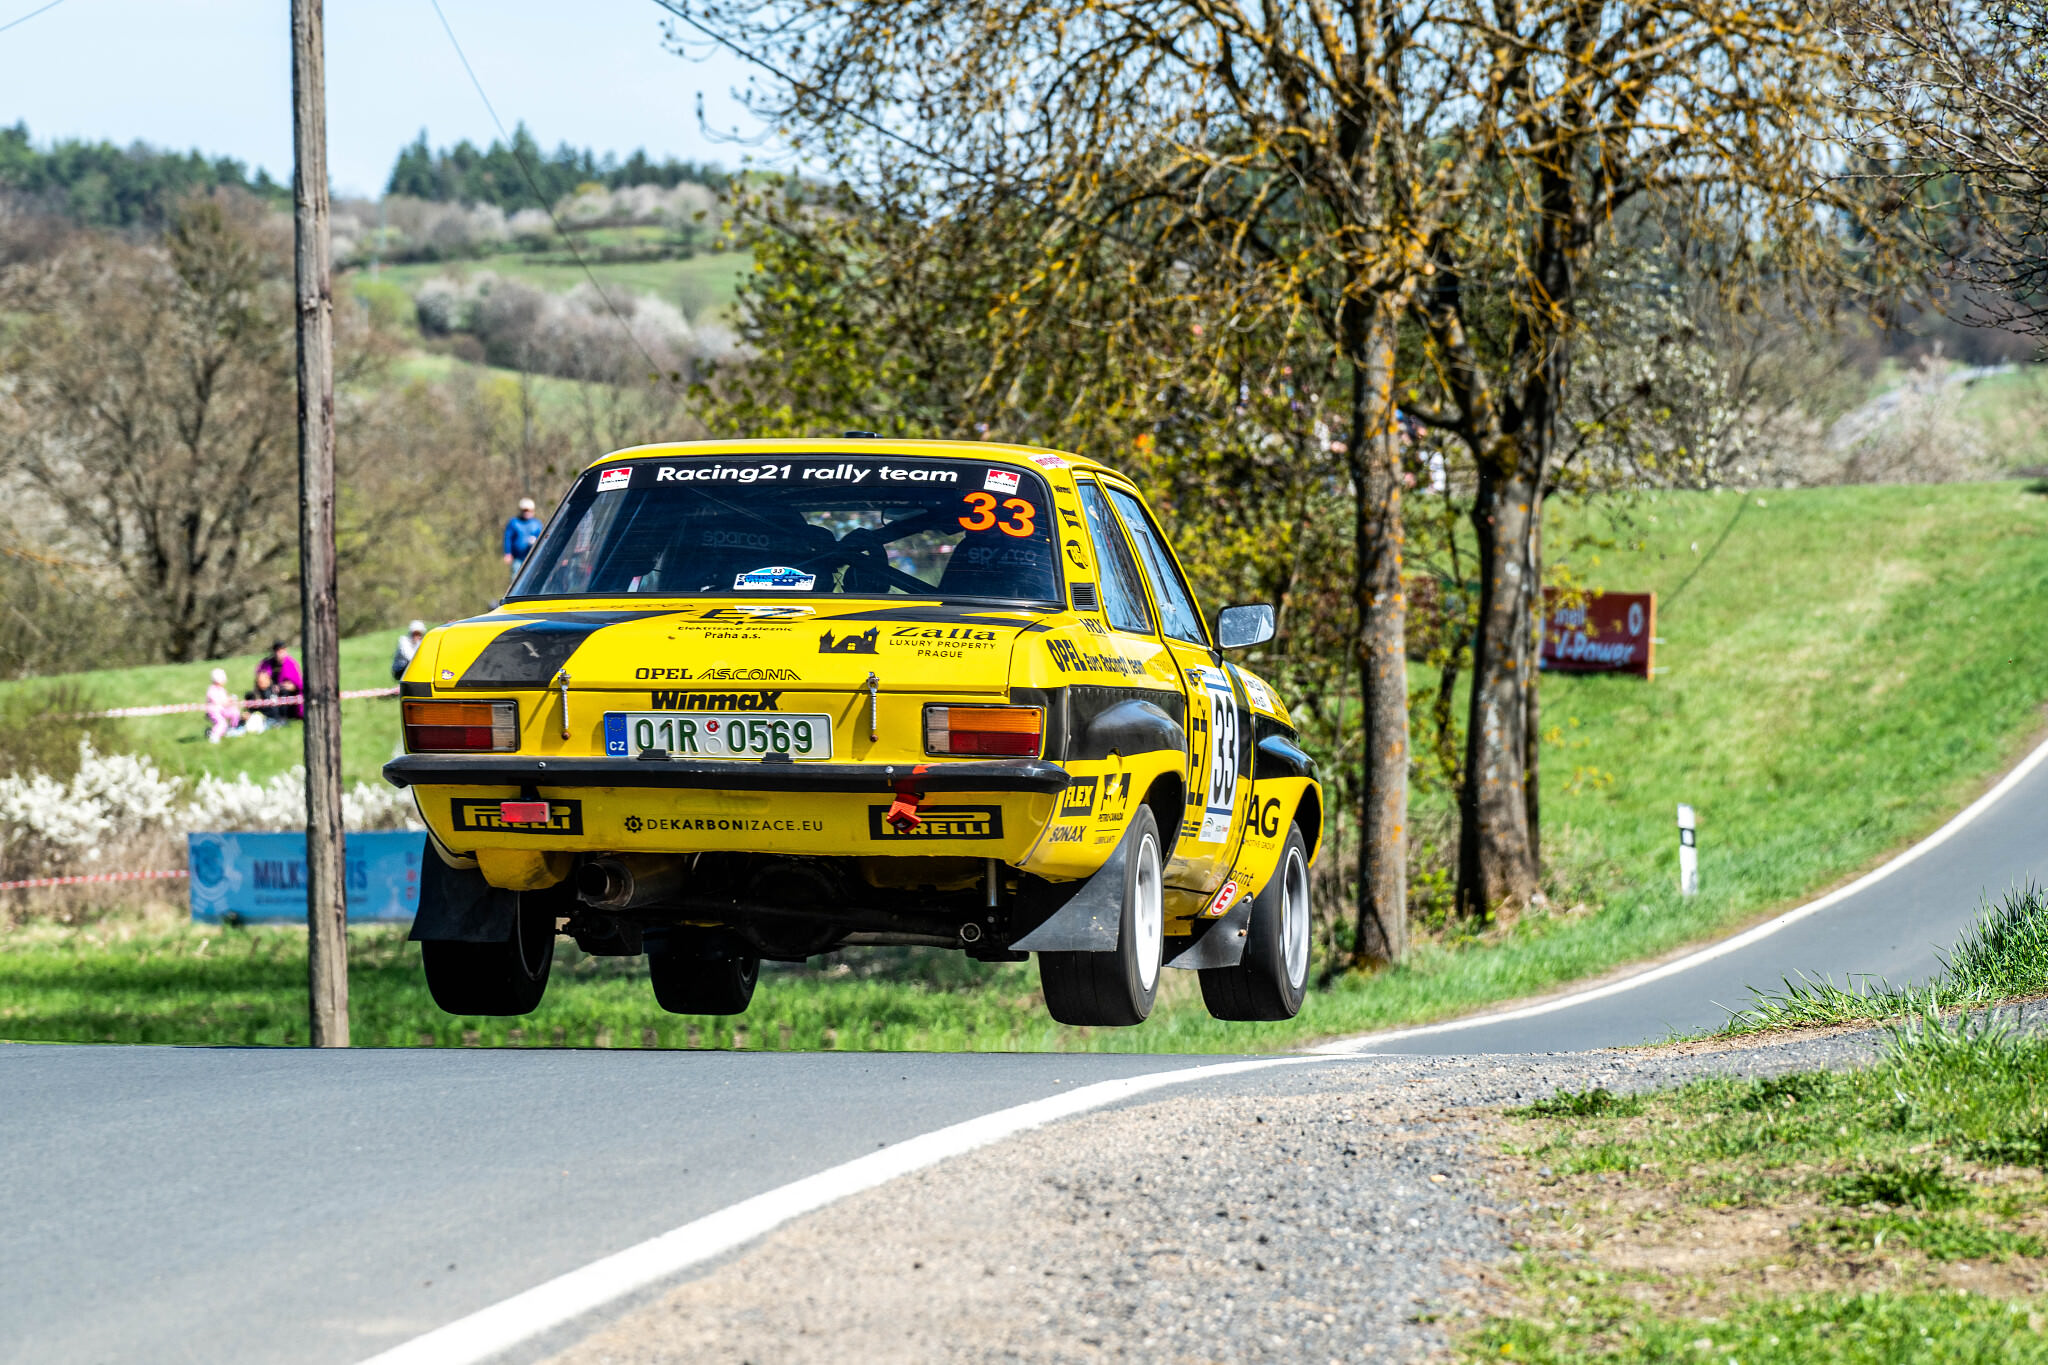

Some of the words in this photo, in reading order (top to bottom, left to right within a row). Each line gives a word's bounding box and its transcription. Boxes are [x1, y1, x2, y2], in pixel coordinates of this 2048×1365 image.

[656, 464, 792, 483] Racing21
[802, 464, 871, 483] rally
[878, 465, 958, 483] team
[958, 491, 1036, 538] 33
[703, 530, 769, 548] sparco
[704, 631, 738, 639] Praha
[891, 626, 997, 641] Zalla
[889, 639, 933, 647] LUXURY
[937, 641, 997, 650] PROPERTY
[917, 650, 963, 659] PRAGUE
[1046, 639, 1088, 673] OPEL
[635, 667, 693, 680] OPEL
[696, 668, 802, 681] ASCONA
[609, 741, 626, 751] CZ
[635, 718, 698, 753] 01R
[727, 719, 812, 754] 0569
[1213, 694, 1236, 806] 33
[1063, 785, 1095, 808] FLEX
[647, 818, 823, 831] DEKARBONIZACE.EU
[1048, 825, 1087, 842] SONAX
[1215, 887, 1234, 909] E
